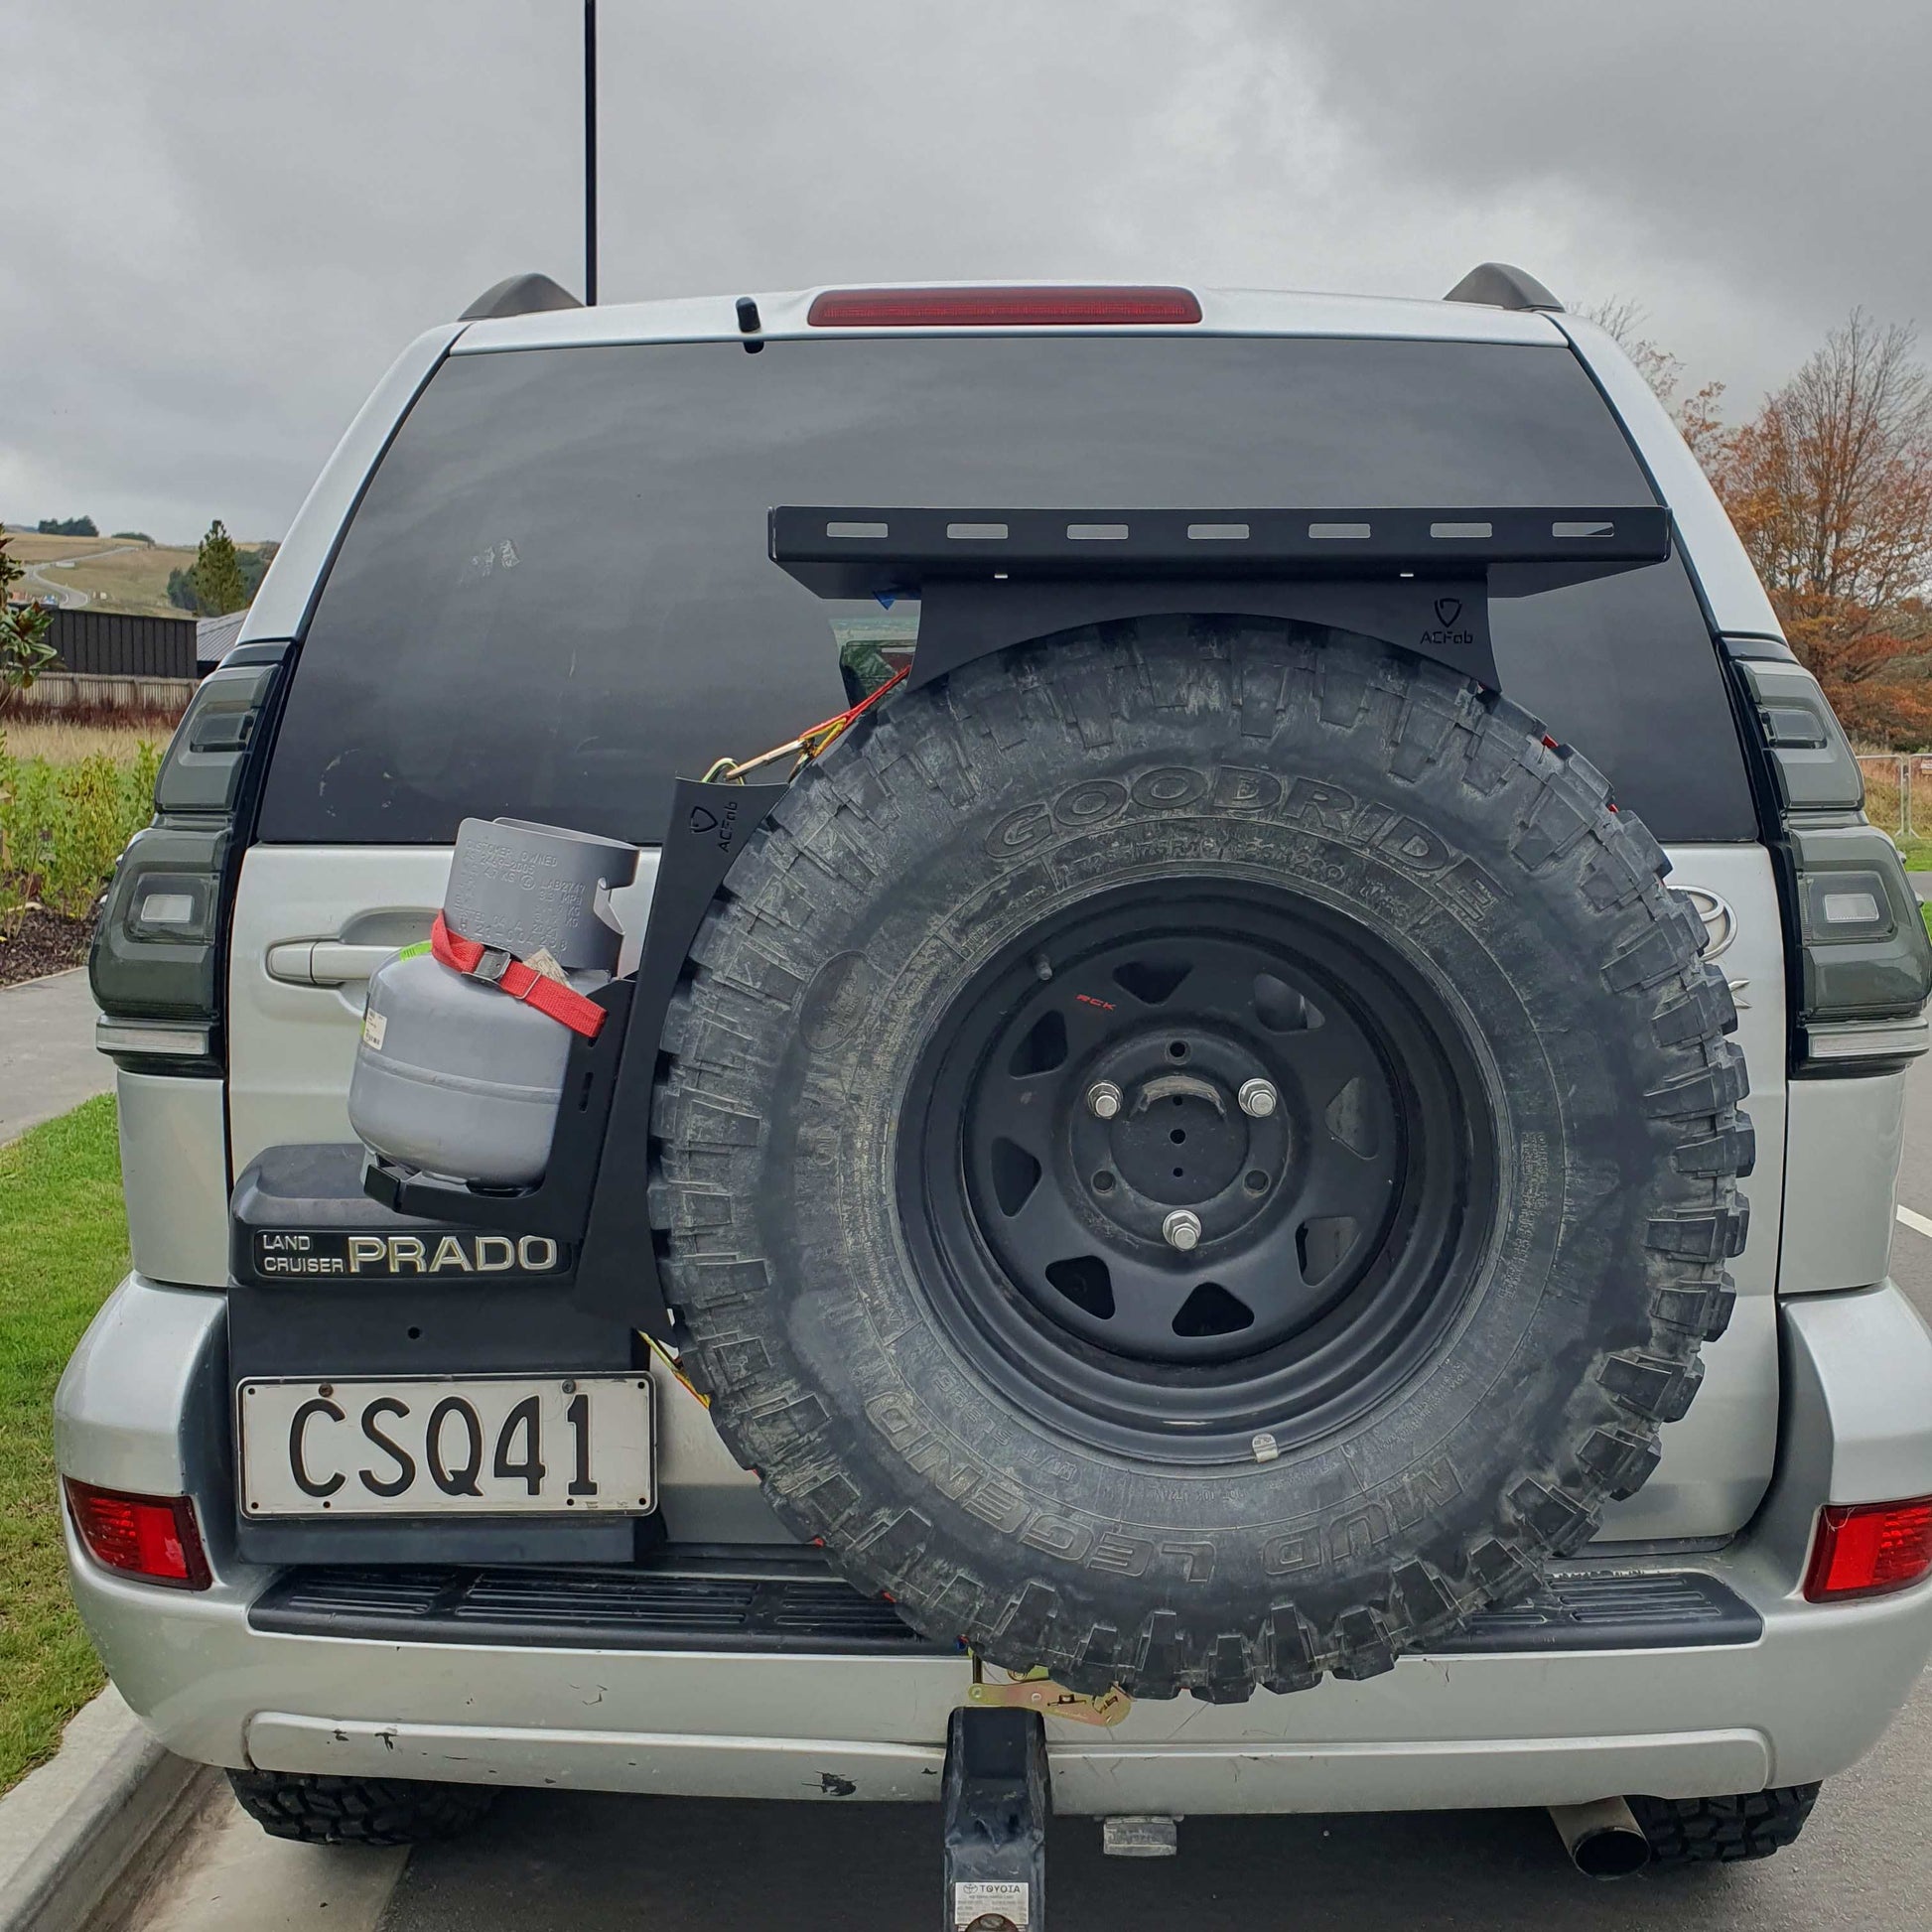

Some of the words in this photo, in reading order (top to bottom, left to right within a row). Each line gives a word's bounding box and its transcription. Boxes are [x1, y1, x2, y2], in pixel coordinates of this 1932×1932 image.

[1420, 629, 1473, 644] ACFab
[985, 763, 1514, 921] GOODRIDE
[262, 1234, 311, 1251] LAND
[347, 1234, 558, 1273] PRADO
[263, 1256, 344, 1273] CRUISER
[289, 1394, 599, 1498] CSQ41
[863, 1391, 1218, 1583] LEGEND
[1262, 1455, 1464, 1578] MUD
[979, 1884, 1021, 1893] TOYOTA
